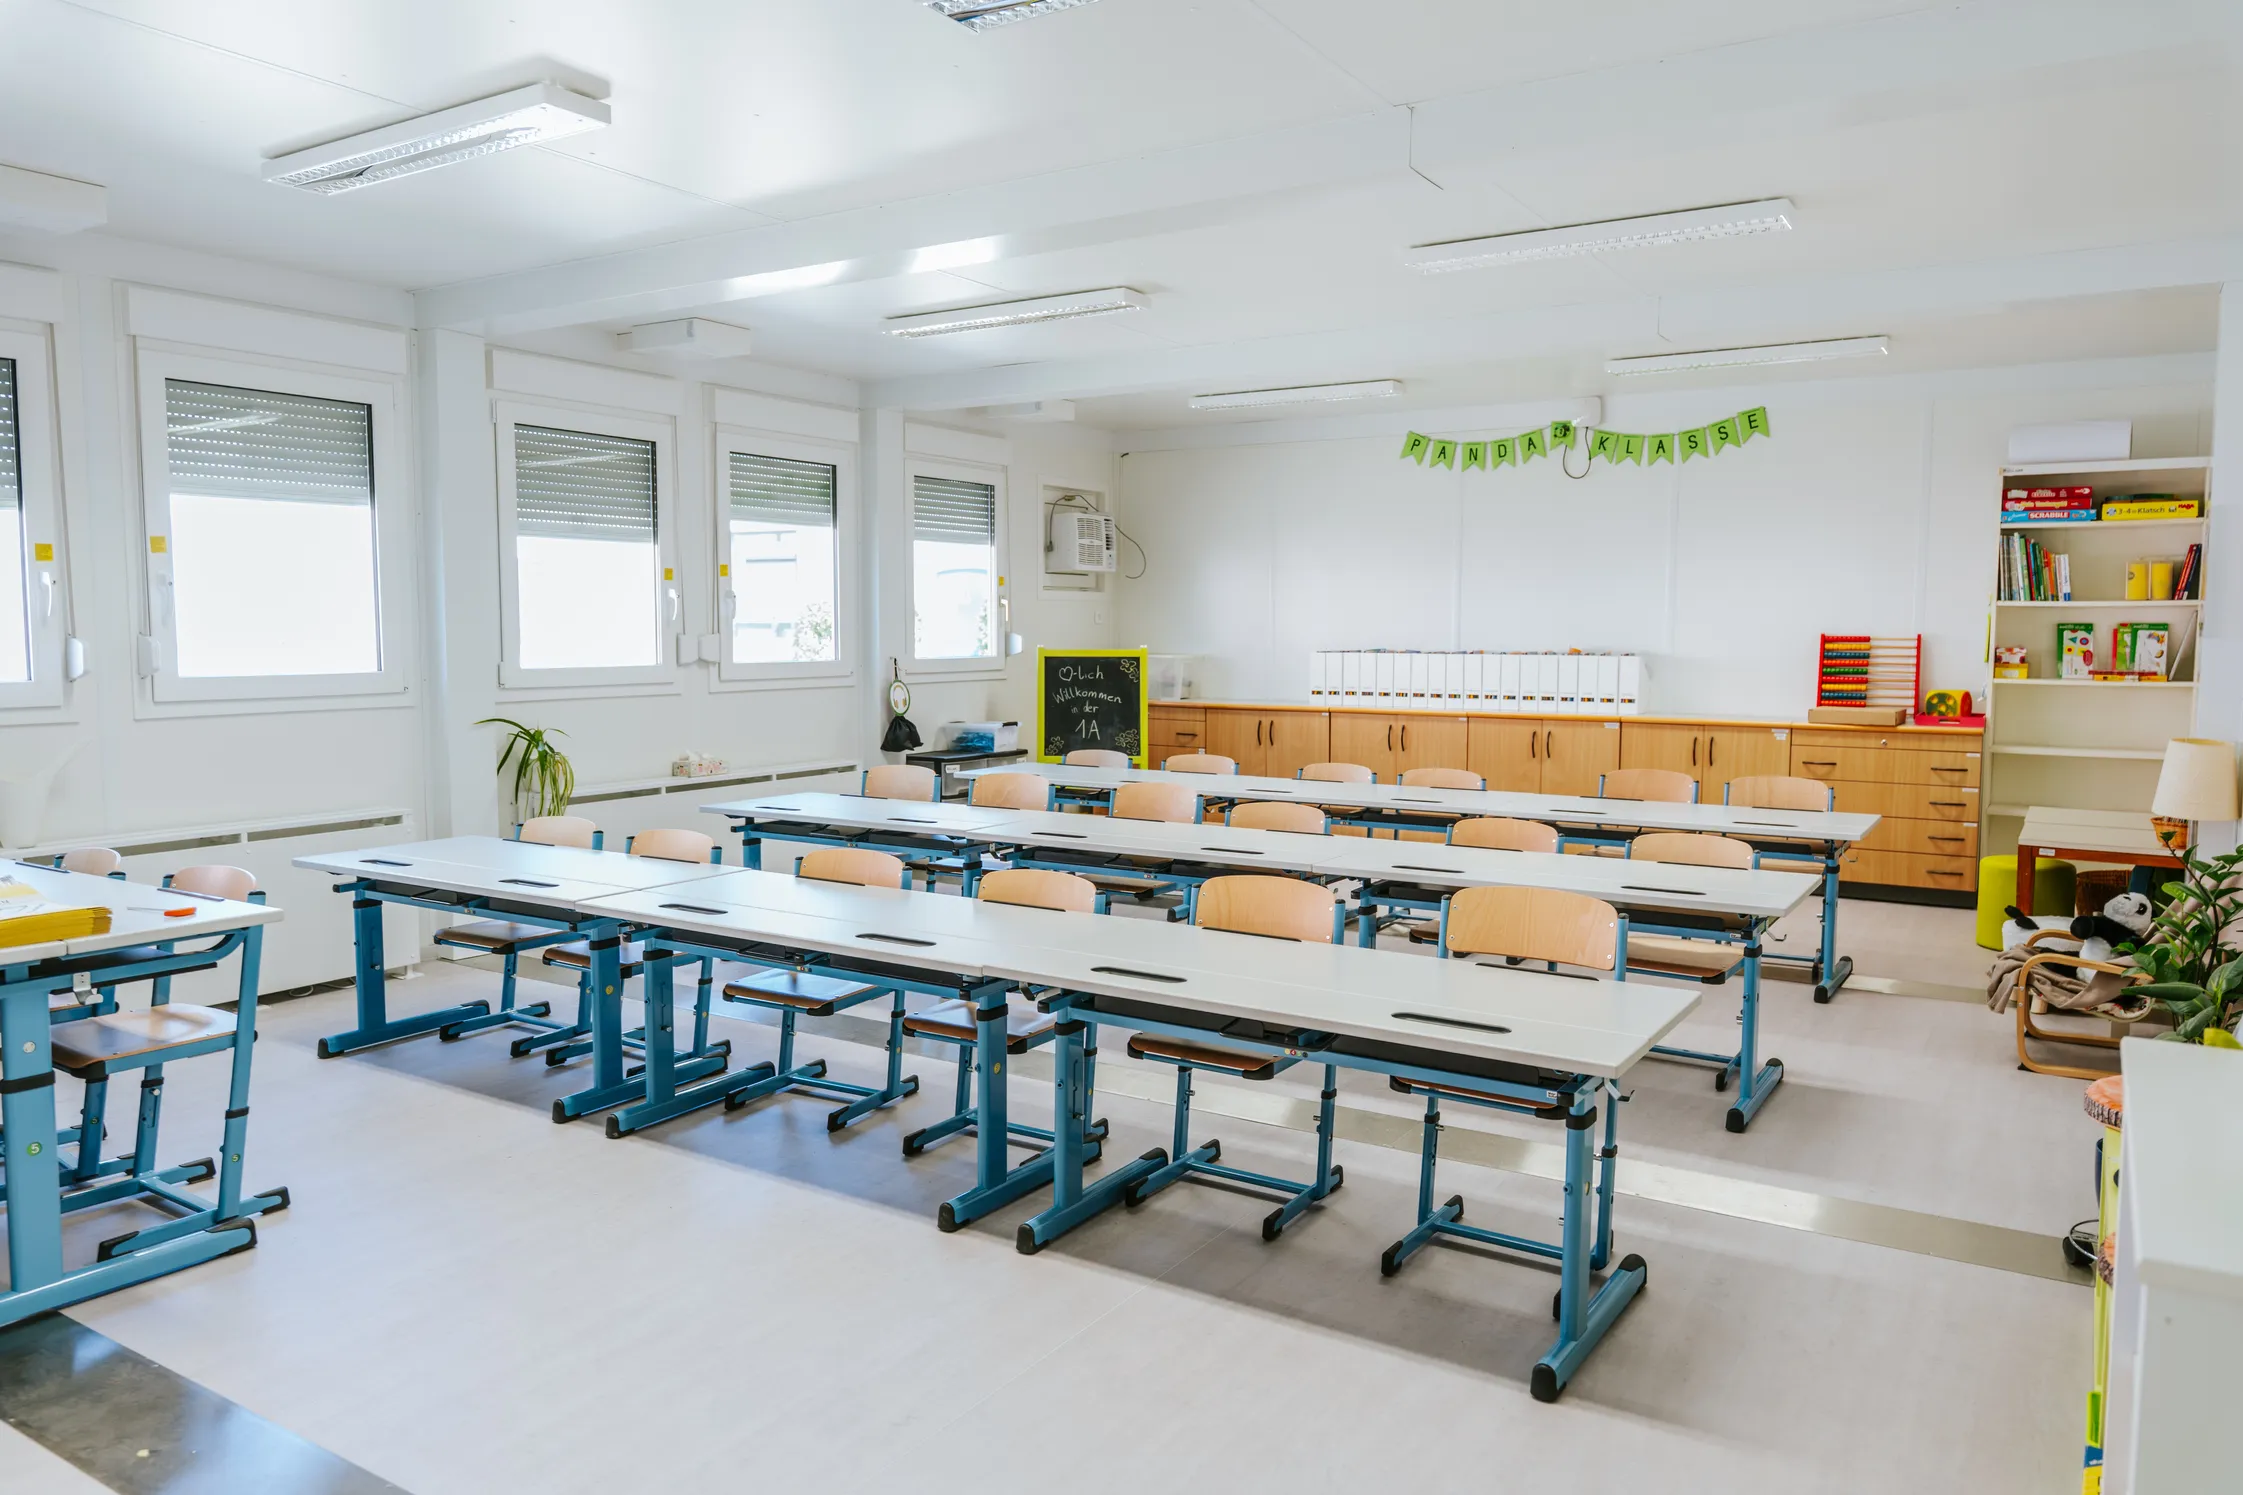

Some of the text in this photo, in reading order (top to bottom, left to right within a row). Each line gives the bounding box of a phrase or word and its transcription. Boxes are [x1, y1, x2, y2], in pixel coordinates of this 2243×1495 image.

[1410, 413, 1759, 462] PANDA KLASSE
[1052, 686, 1122, 704] Willkommen
[1070, 700, 1099, 714] in der
[1075, 719, 1101, 740] 1A
[31, 1143, 40, 1154] 5
